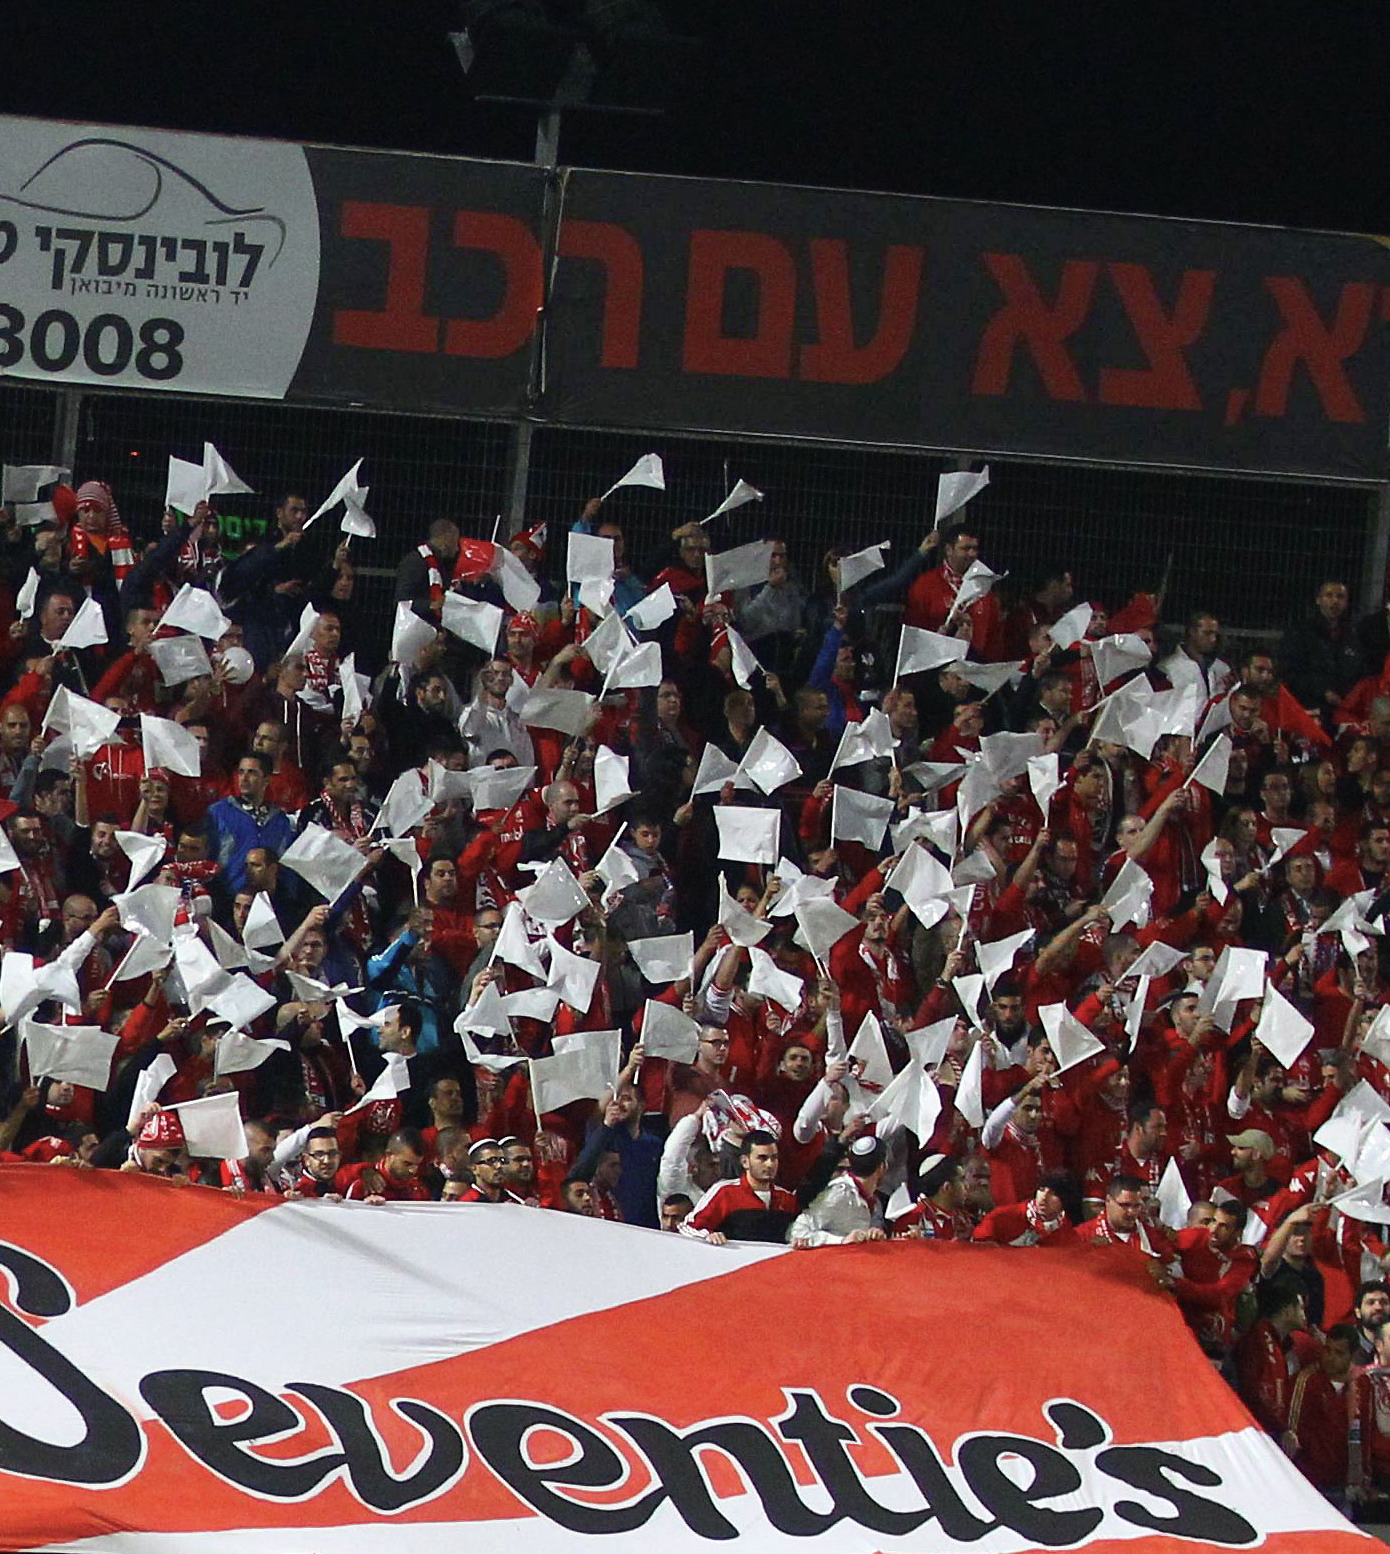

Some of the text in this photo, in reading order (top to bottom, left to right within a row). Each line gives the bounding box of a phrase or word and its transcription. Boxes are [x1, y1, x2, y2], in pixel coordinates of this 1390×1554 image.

[34, 224, 264, 290] לובינסקי
[70, 277, 249, 305] יד ראשונה מיבואן
[332, 200, 645, 368] רכב
[682, 228, 926, 385] עם
[971, 252, 1217, 410] צא
